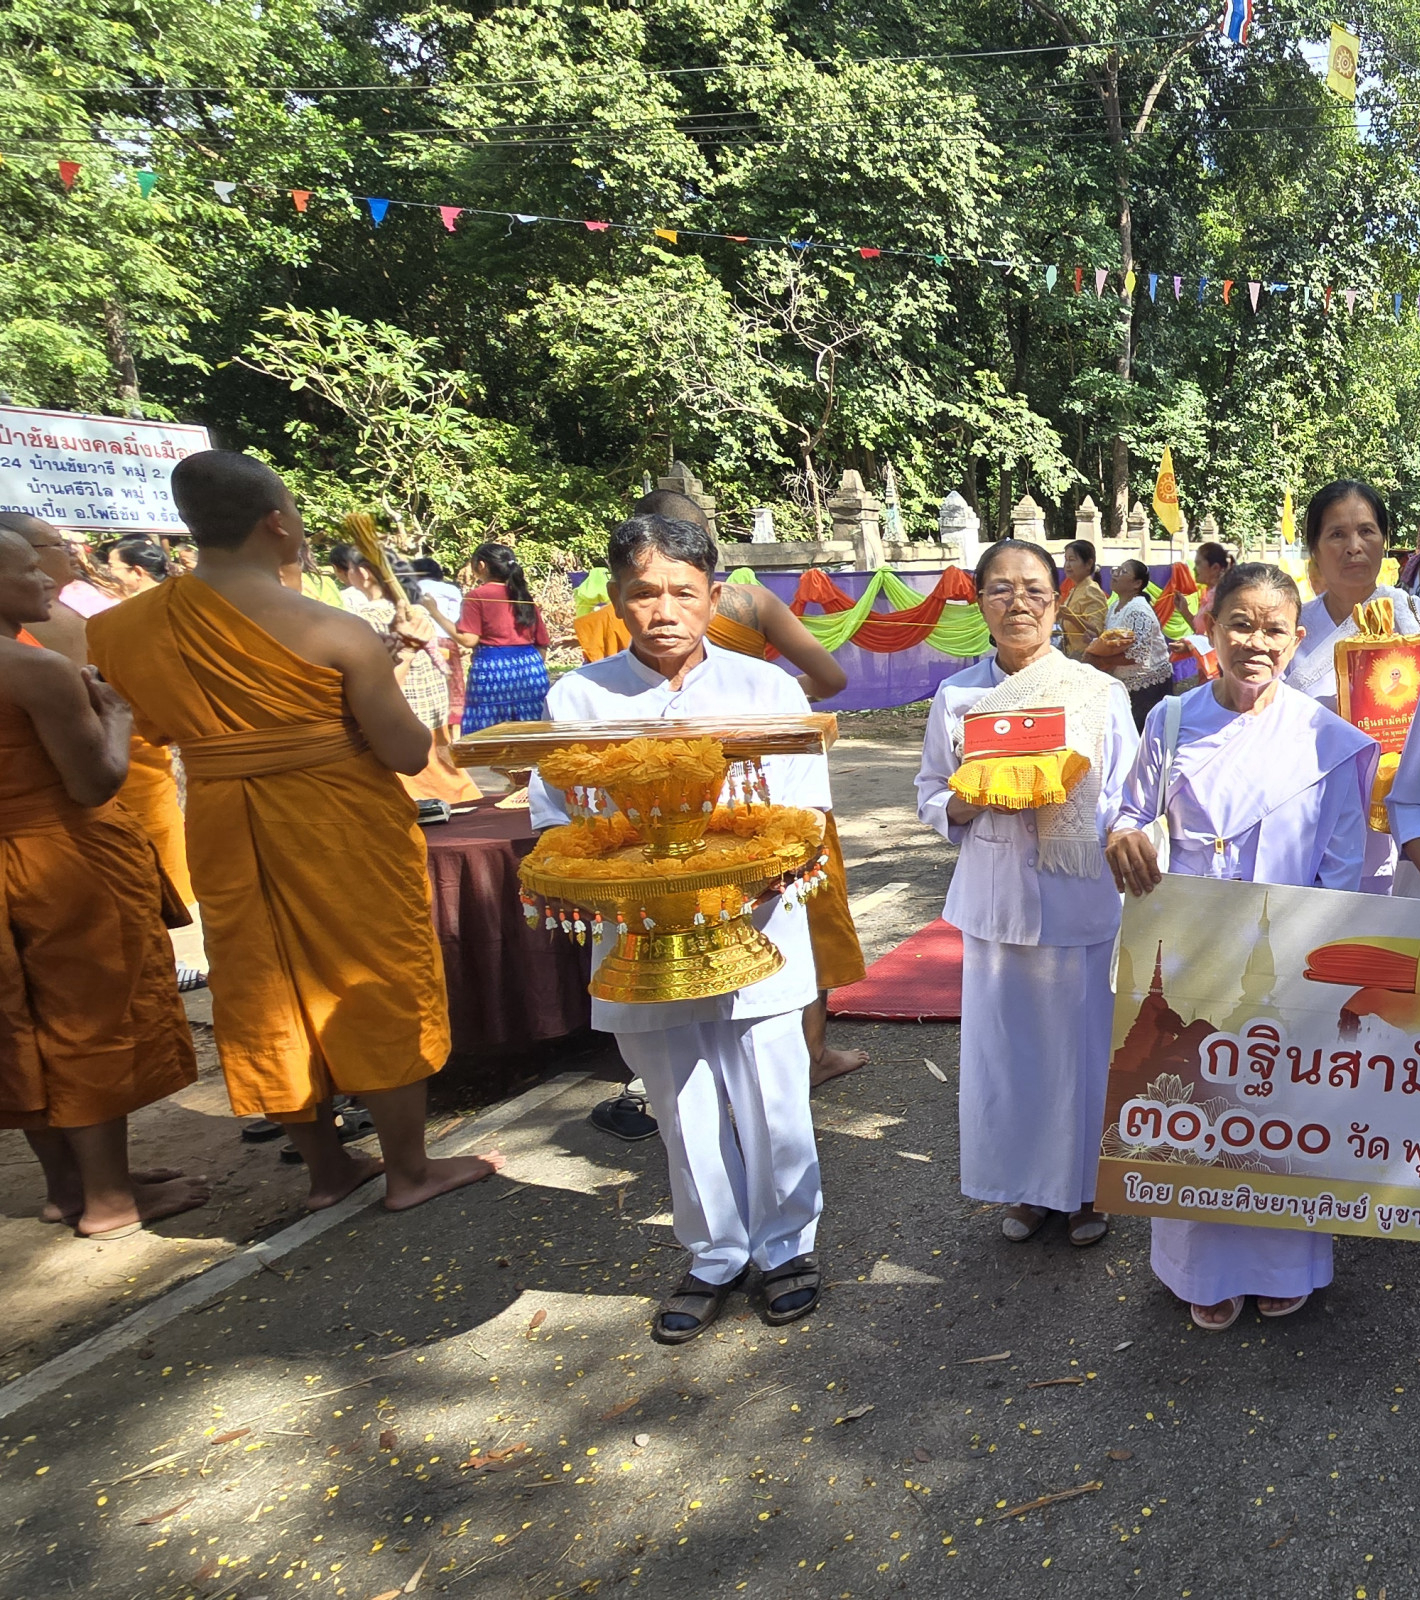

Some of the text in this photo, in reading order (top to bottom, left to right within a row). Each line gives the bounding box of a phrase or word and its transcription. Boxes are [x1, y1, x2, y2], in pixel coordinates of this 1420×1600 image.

[30, 453, 115, 475] บ้านชัยวารี
[122, 464, 147, 483] หมู่
[27, 477, 169, 504] บ้านศรีวิไล หมู่ 13
[147, 507, 179, 522] จ.ร้อ
[1126, 1105, 1331, 1153] ๓๐,๐๐๐
[1347, 1121, 1390, 1161] วัด
[1126, 1174, 1171, 1202] โดย
[1181, 1185, 1368, 1224] คณะศิษยานุศิษย์
